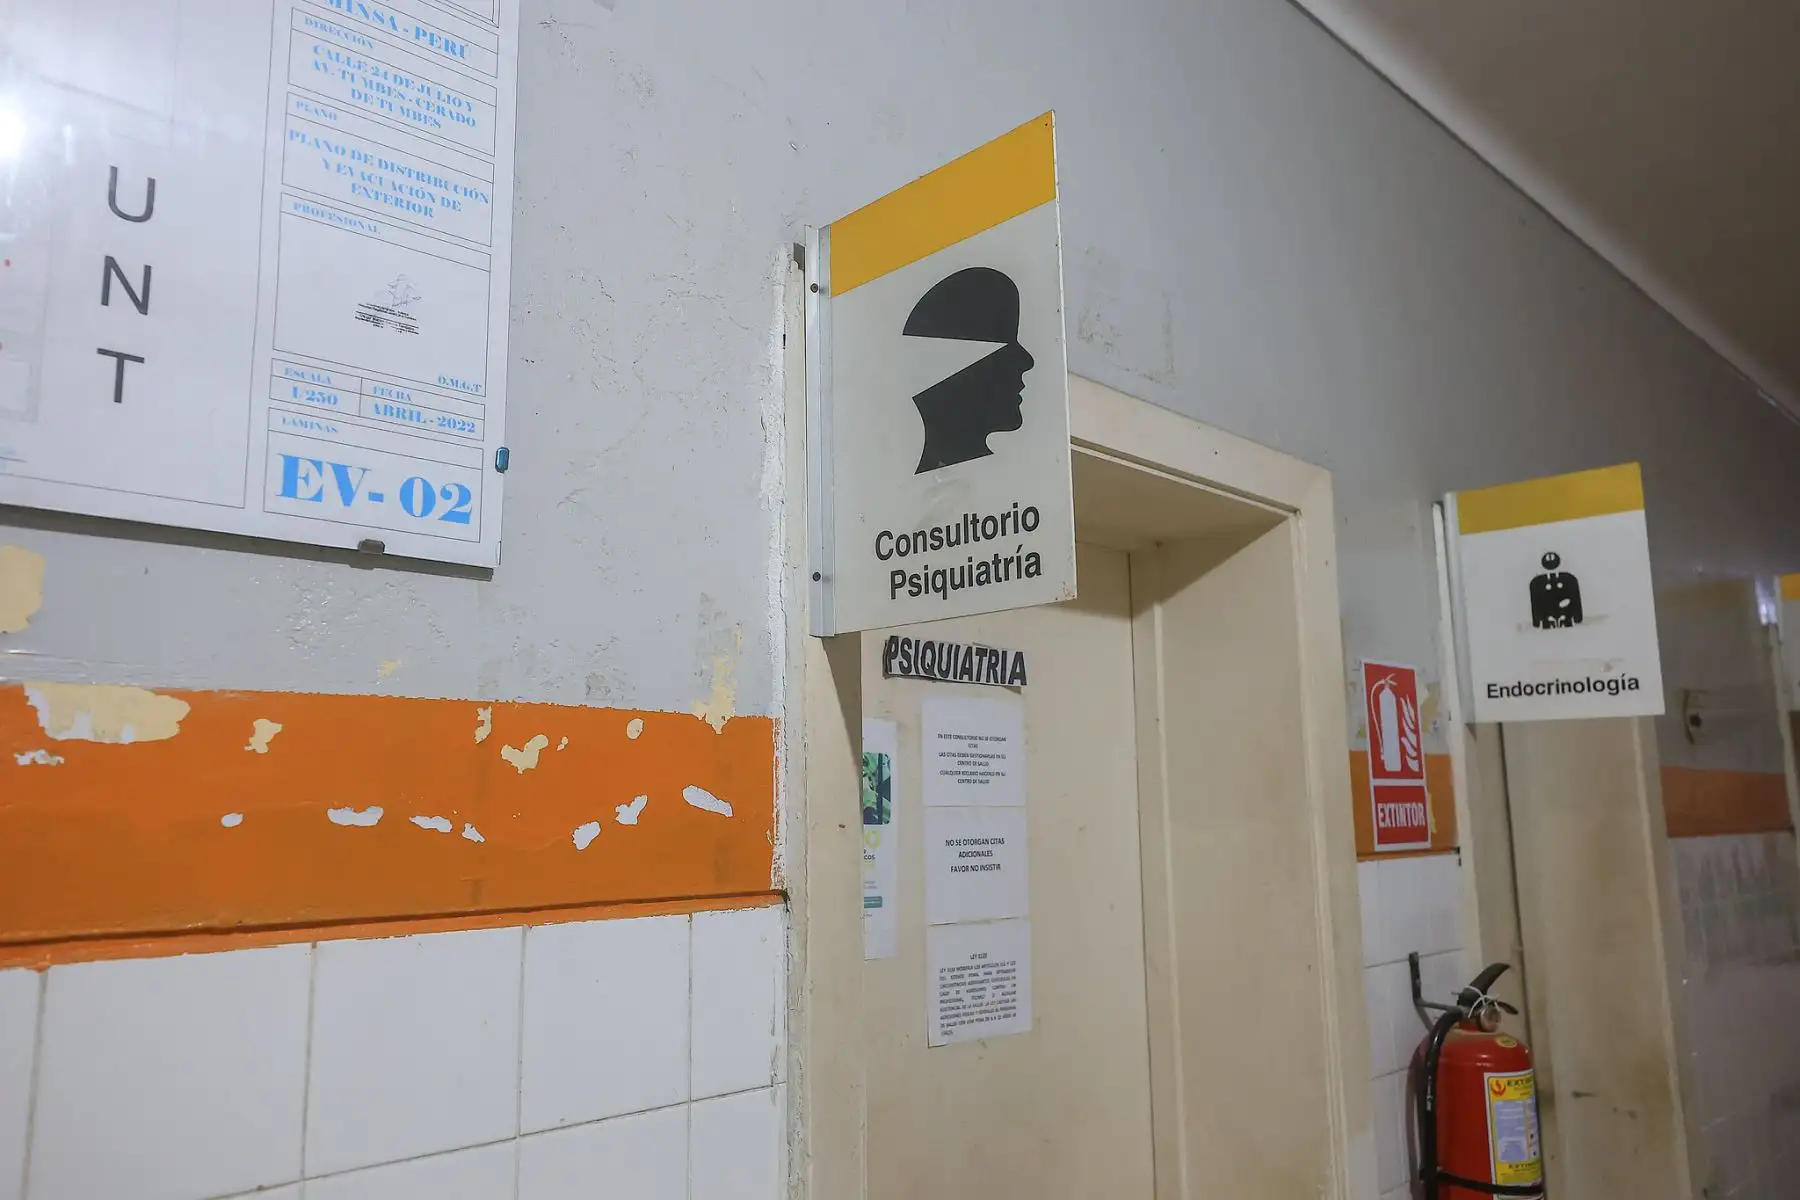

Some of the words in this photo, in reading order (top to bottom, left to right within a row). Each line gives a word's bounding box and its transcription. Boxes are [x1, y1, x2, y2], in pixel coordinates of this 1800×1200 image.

[312, 44, 368, 73] CALLE
[393, 74, 415, 91] DE
[418, 83, 462, 108] JULIO
[466, 100, 473, 113] Y
[337, 67, 406, 101] TUMBES
[295, 101, 338, 121] PLANO
[351, 88, 374, 105] DE
[376, 96, 442, 130] TUMBES
[288, 129, 347, 157] PLANO
[350, 147, 374, 166] DE
[320, 157, 331, 171] Y
[440, 196, 463, 212] DE
[351, 183, 435, 219] EXTERIOR
[284, 366, 332, 385] ESCALA
[373, 385, 412, 402] FECHA
[373, 403, 427, 424] ABRIL
[437, 415, 477, 433] 2022
[399, 476, 472, 525] 02
[875, 502, 1040, 561] Consultorio
[890, 543, 1042, 600] Psiquiatría
[884, 635, 1028, 686] PSIQUIATRIA
[1487, 673, 1640, 700] Endocrinología
[1376, 801, 1426, 829] EXTINTOR
[945, 839, 955, 847] NO
[962, 838, 989, 846] OTORGAN
[958, 850, 993, 858] ADICIONALES
[951, 865, 969, 873] FAVOR
[970, 864, 979, 872] NO
[980, 863, 1001, 872] INSISTIR
